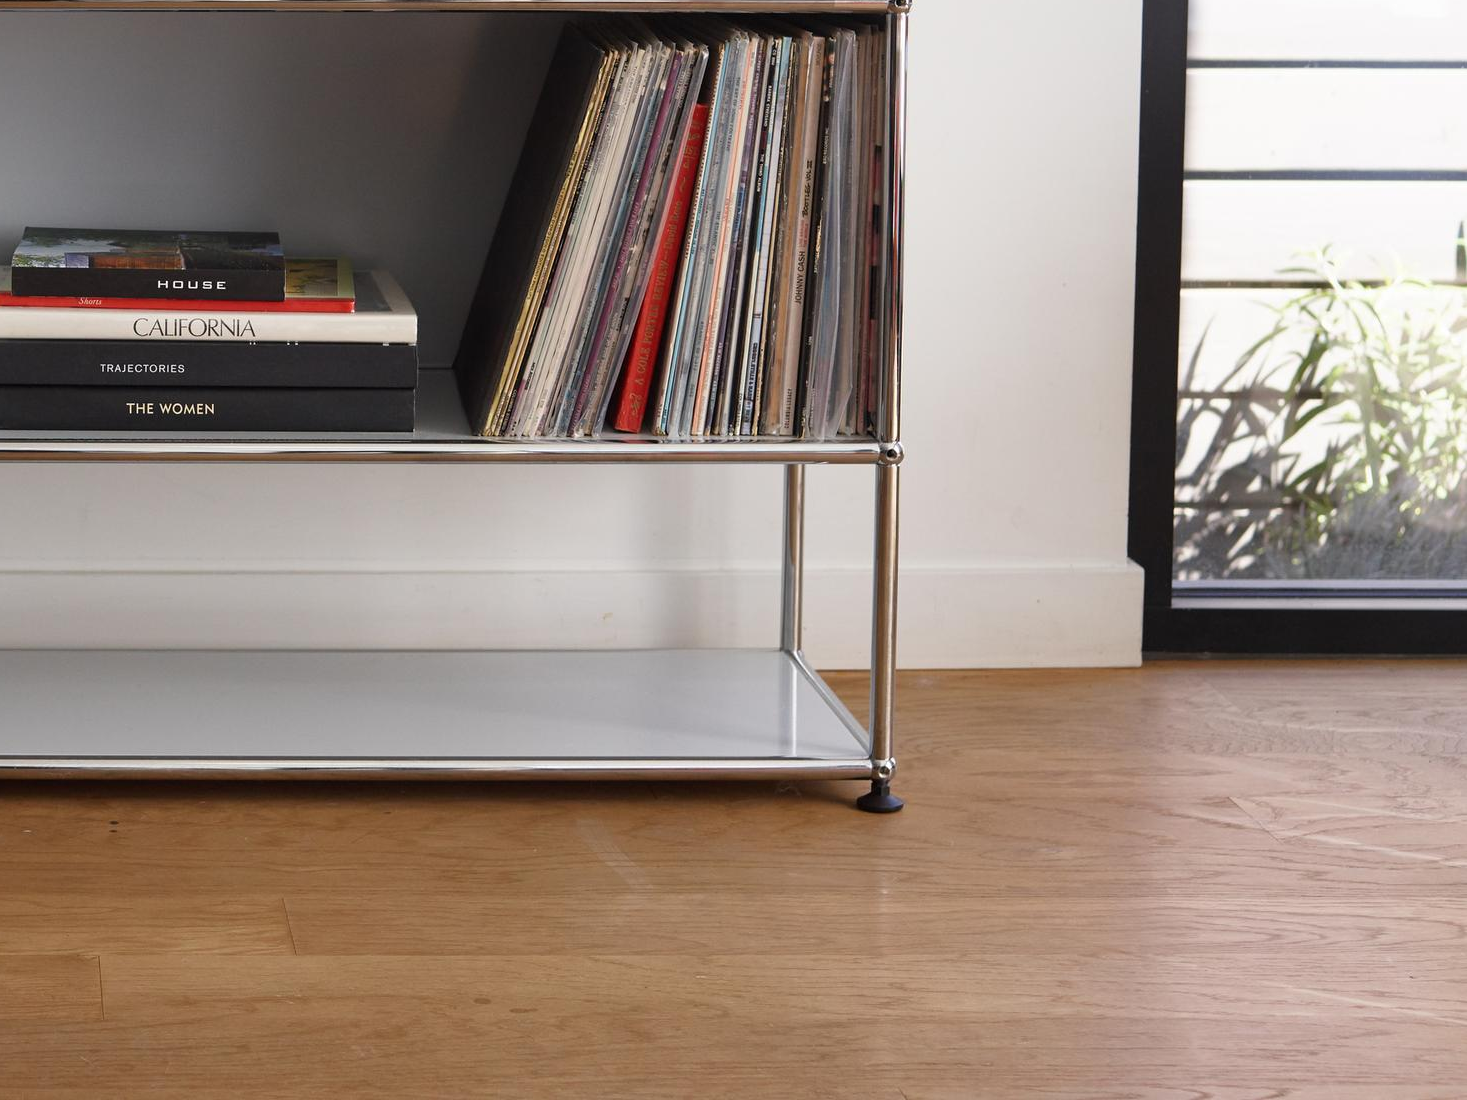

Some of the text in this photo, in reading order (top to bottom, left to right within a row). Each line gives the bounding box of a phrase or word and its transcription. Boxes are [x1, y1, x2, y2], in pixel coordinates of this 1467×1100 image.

[801, 183, 811, 217] BOOTLEG
[157, 280, 227, 290] HOUSE
[794, 250, 806, 304] JOHNNY CASH
[78, 297, 102, 306] Shorts
[133, 317, 256, 338] CALIFORNIA
[637, 346, 649, 374] COLE
[643, 303, 659, 344] PORTER
[100, 363, 185, 373] TRAJECTORIES
[126, 402, 215, 415] THE WOMEN
